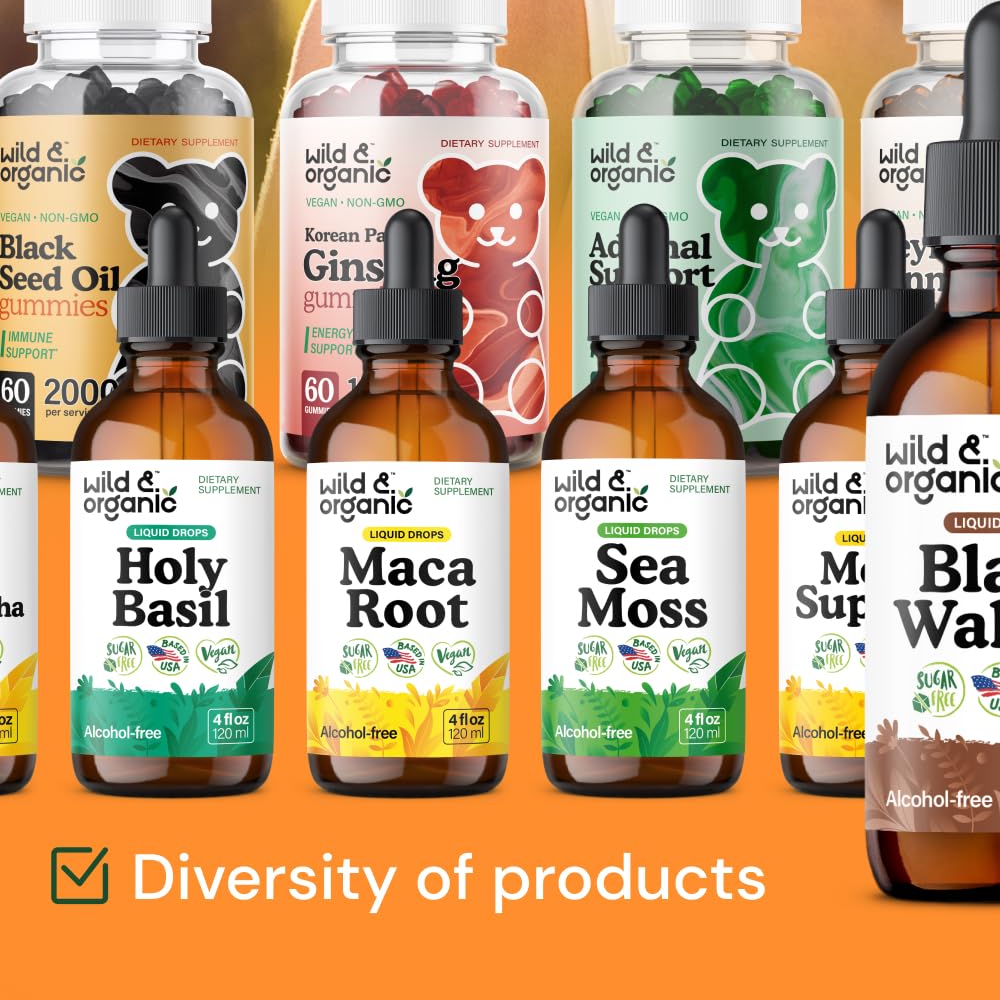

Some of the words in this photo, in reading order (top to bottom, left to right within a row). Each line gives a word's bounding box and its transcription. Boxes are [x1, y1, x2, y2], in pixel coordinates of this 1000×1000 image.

[1, 142, 40, 162] wild
[131, 138, 177, 146] DIETARY
[181, 139, 238, 147] SUPPLEMENT
[441, 140, 484, 148] DIETARY
[488, 140, 539, 148] SUPPLEMENT
[591, 142, 630, 163] wild
[721, 139, 767, 147] DIETARY
[771, 139, 828, 148] SUPPLEMENT
[305, 143, 346, 164] wild
[880, 143, 919, 164] wild
[1, 159, 85, 190] organic
[305, 160, 391, 191] organic
[591, 159, 675, 191] organic
[306, 198, 337, 207] VEGAN
[347, 197, 405, 208] NON-GMO
[1, 213, 30, 222] VEGAN
[40, 213, 99, 222] NON-GMO
[590, 211, 621, 221] VEGAN
[304, 227, 360, 243] Korean
[588, 231, 712, 260] Adnal
[0, 234, 76, 260] Black
[0, 265, 62, 292] Seed
[71, 266, 120, 292] Oil
[303, 249, 460, 290] Ginsg
[589, 259, 716, 288] Suort
[0, 293, 109, 320] gummies
[8, 331, 53, 344] IMMUNE
[311, 327, 353, 340] ENERGY
[6, 347, 55, 359] SUPPORT
[1, 377, 30, 404] 60
[44, 378, 118, 405] 2000
[304, 376, 335, 404] 60
[886, 434, 948, 465] wild
[83, 471, 129, 493] wild
[320, 472, 366, 495] wild
[434, 477, 473, 486] DIETARY
[555, 470, 600, 492] wild
[669, 475, 709, 483] DIETARY
[669, 485, 730, 493] SUPPLEMENT
[792, 472, 838, 495] wild
[198, 486, 261, 494] SUPPLEMENT
[434, 487, 494, 496] SUPPLEMENT
[83, 489, 177, 522] organic
[320, 490, 413, 523] organic
[555, 488, 648, 521] organic
[133, 528, 170, 537] LIQUID
[172, 528, 208, 537] DROPS
[370, 530, 405, 539] LIQUID
[408, 531, 444, 539] DROPS
[605, 526, 641, 536] LIQUID
[643, 526, 680, 535] DROPS
[117, 547, 228, 592] Holy
[340, 546, 476, 587] Maca
[596, 543, 689, 585] Sea
[113, 589, 230, 627] Basil
[346, 589, 469, 629] Root
[578, 587, 708, 628] Moss
[916, 669, 957, 690] SUGAR
[931, 690, 955, 707] FREE
[84, 726, 162, 739] Alcohol-free
[213, 728, 232, 739] 120
[321, 726, 398, 739] Alcohol-free
[449, 729, 467, 740] 120
[555, 725, 633, 739] Alcohol-free
[886, 790, 993, 808] Alcohol-free
